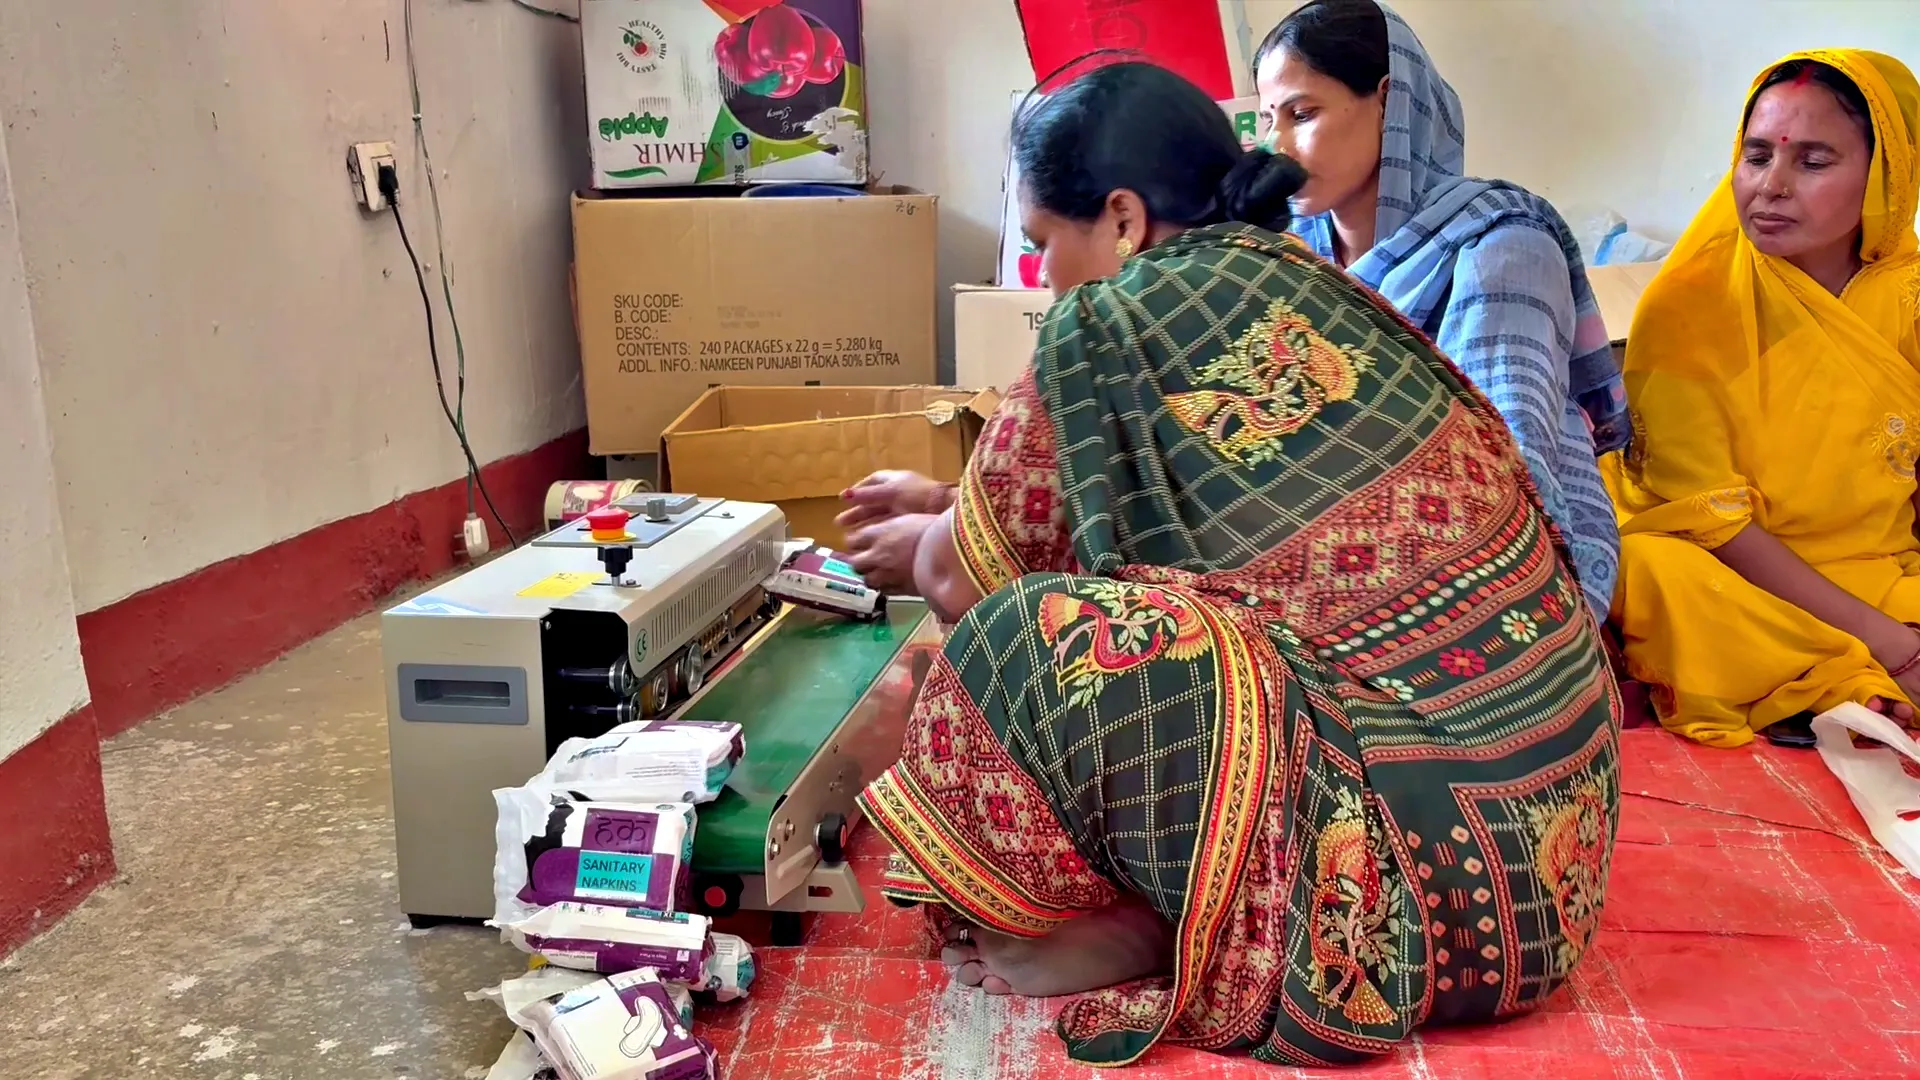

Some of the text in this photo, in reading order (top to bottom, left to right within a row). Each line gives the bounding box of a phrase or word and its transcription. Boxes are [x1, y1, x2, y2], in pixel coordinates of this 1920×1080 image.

[628, 19, 665, 40] HEALTHY
[631, 63, 657, 74] TASTY
[766, 106, 793, 120] Juicy
[598, 112, 669, 141] Apple
[614, 293, 683, 308] SKU CODE:
[614, 309, 672, 324] B. CODE:
[615, 326, 659, 340] DESC.:
[616, 341, 691, 357] CONTENTS:
[700, 341, 721, 355] 240
[724, 338, 783, 355] PACKAGES
[786, 342, 792, 352] x
[795, 339, 809, 352] 22
[812, 341, 819, 355] g
[835, 336, 867, 352] 5.280
[869, 336, 882, 353] kg
[618, 352, 900, 373] ADDL. INFO.: NAMKEEN PUNJABI TADKA 50% EXTRA
[582, 857, 646, 874] SANITARY
[581, 876, 638, 892] NAPKINS
